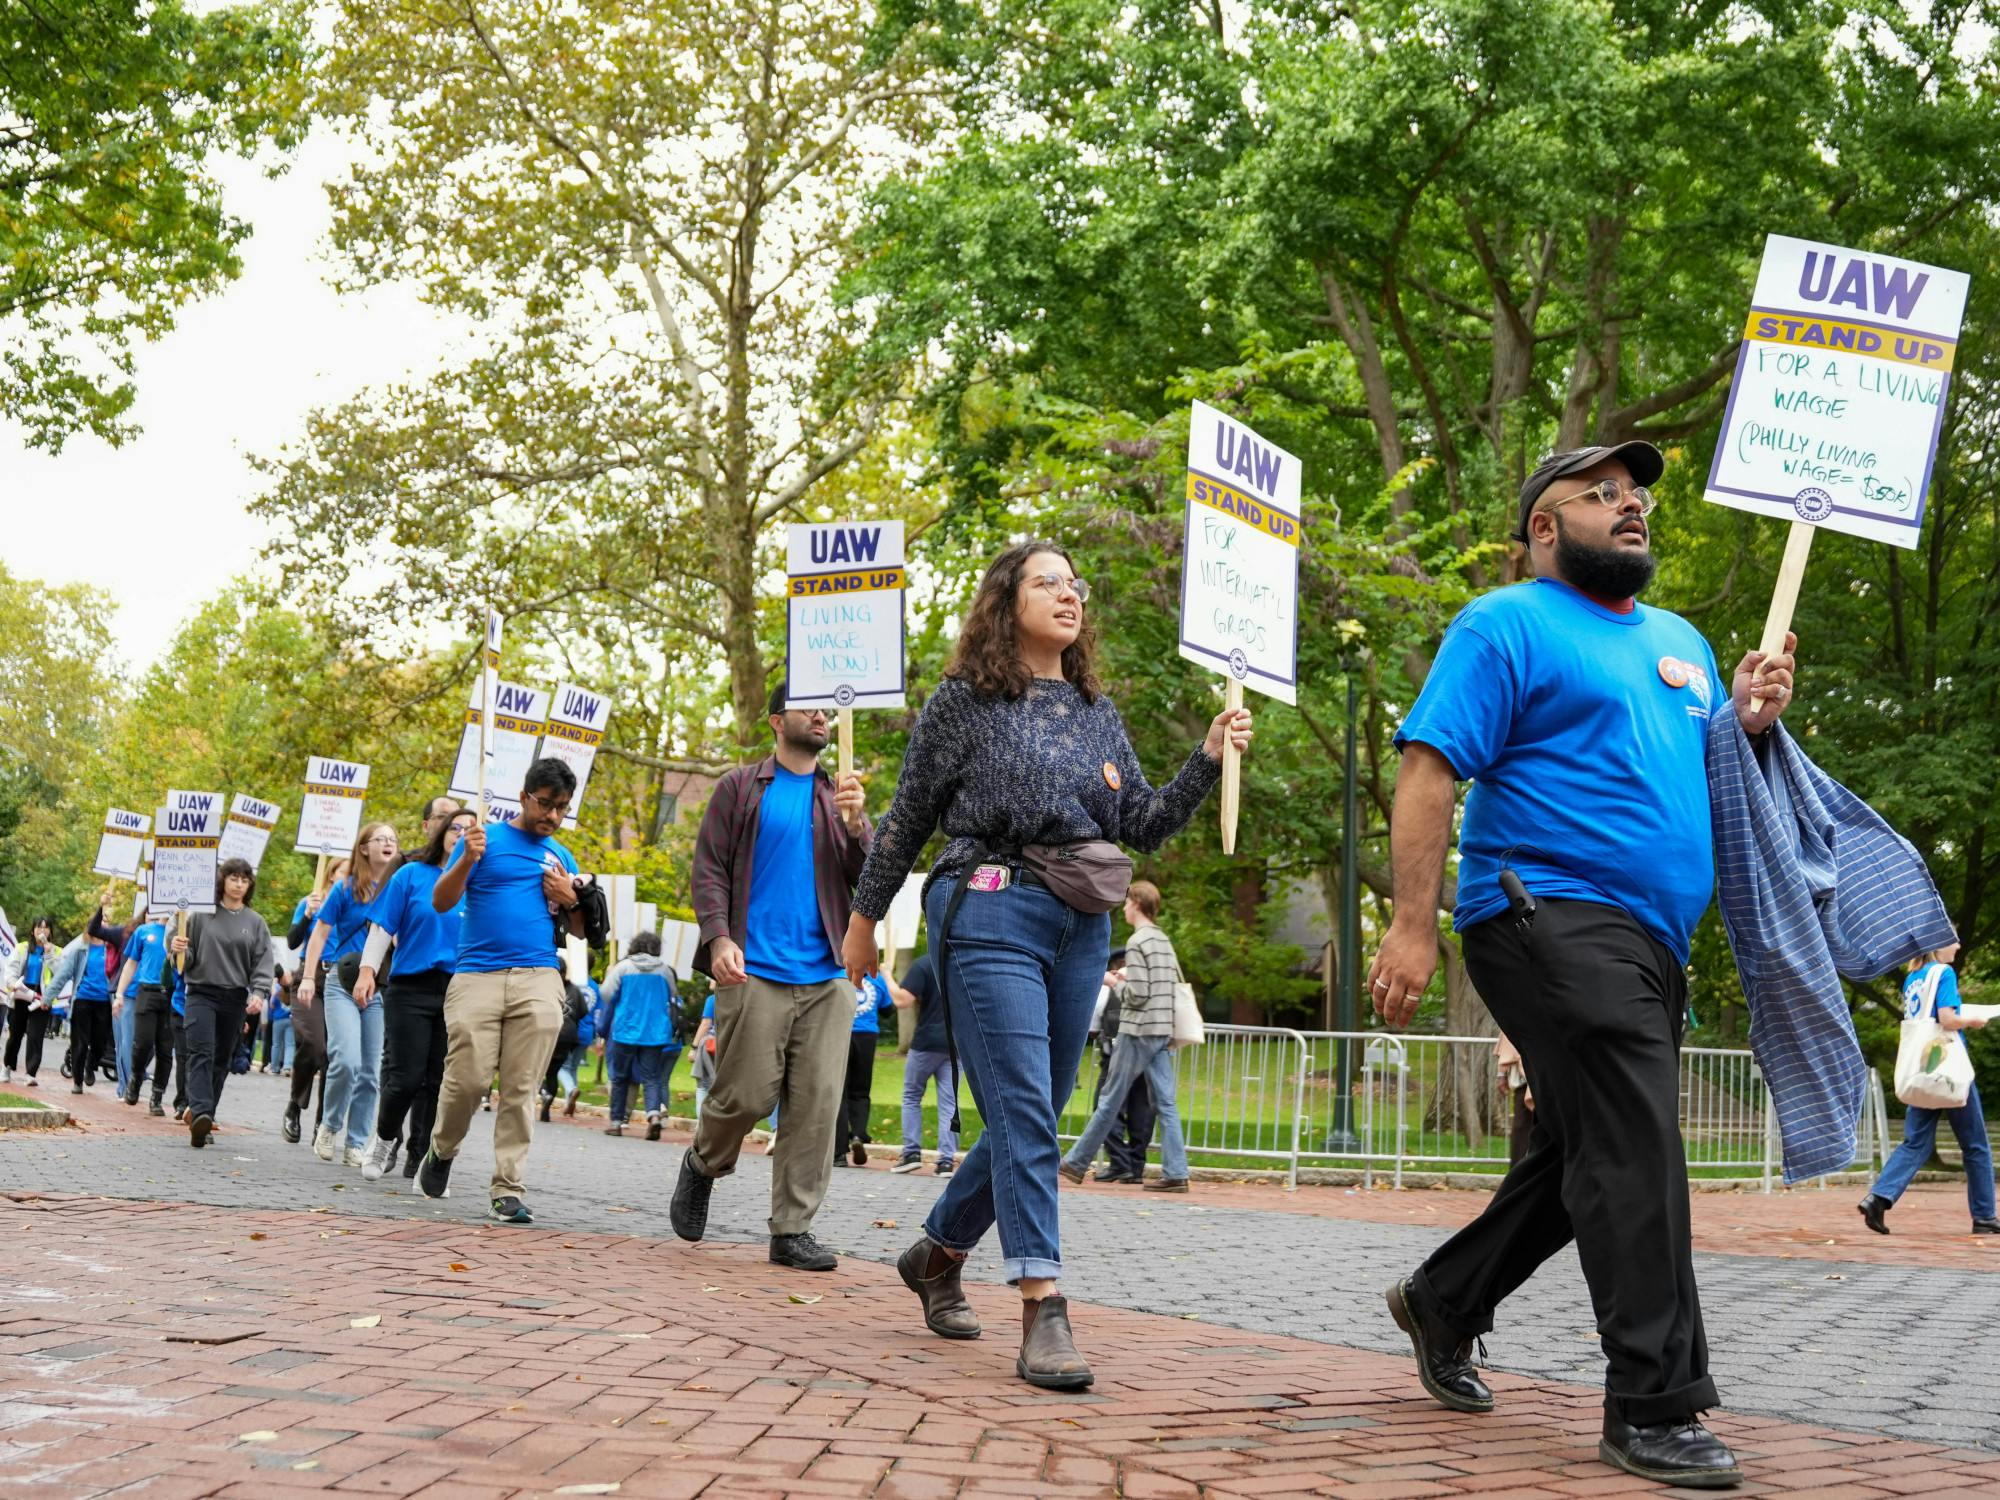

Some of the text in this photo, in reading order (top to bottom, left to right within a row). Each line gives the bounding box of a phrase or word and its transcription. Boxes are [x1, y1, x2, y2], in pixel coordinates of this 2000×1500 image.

[1799, 251, 1930, 320] UAW
[1756, 318, 1944, 364] STAND UP
[1759, 346, 1941, 406] FOR A LIVING
[1775, 388, 1848, 418] WAGE
[1216, 420, 1282, 498] UAW
[1817, 440, 1877, 468] LIVING
[1194, 480, 1294, 538] STAND UP
[811, 527, 881, 564] UAW
[1204, 516, 1240, 553] FOR
[793, 572, 898, 595] STAND UP
[1201, 559, 1285, 620] INTERNAT'L
[800, 604, 872, 626] LIVING
[808, 631, 864, 650] WAGE
[1214, 608, 1266, 652] GRADS
[563, 689, 601, 723] UAW
[471, 713, 538, 734] SND UP
[549, 724, 598, 745] STAND UP
[320, 762, 357, 783] UAW
[309, 785, 344, 796] STAND
[179, 793, 212, 811] UAW
[242, 799, 270, 818] UAW
[115, 812, 141, 828] UAW
[168, 812, 207, 832] UAW
[158, 838, 215, 847] STAND UP
[156, 850, 204, 862] PENN CAN
[199, 864, 212, 872] TO
[159, 888, 199, 898] WAGE
